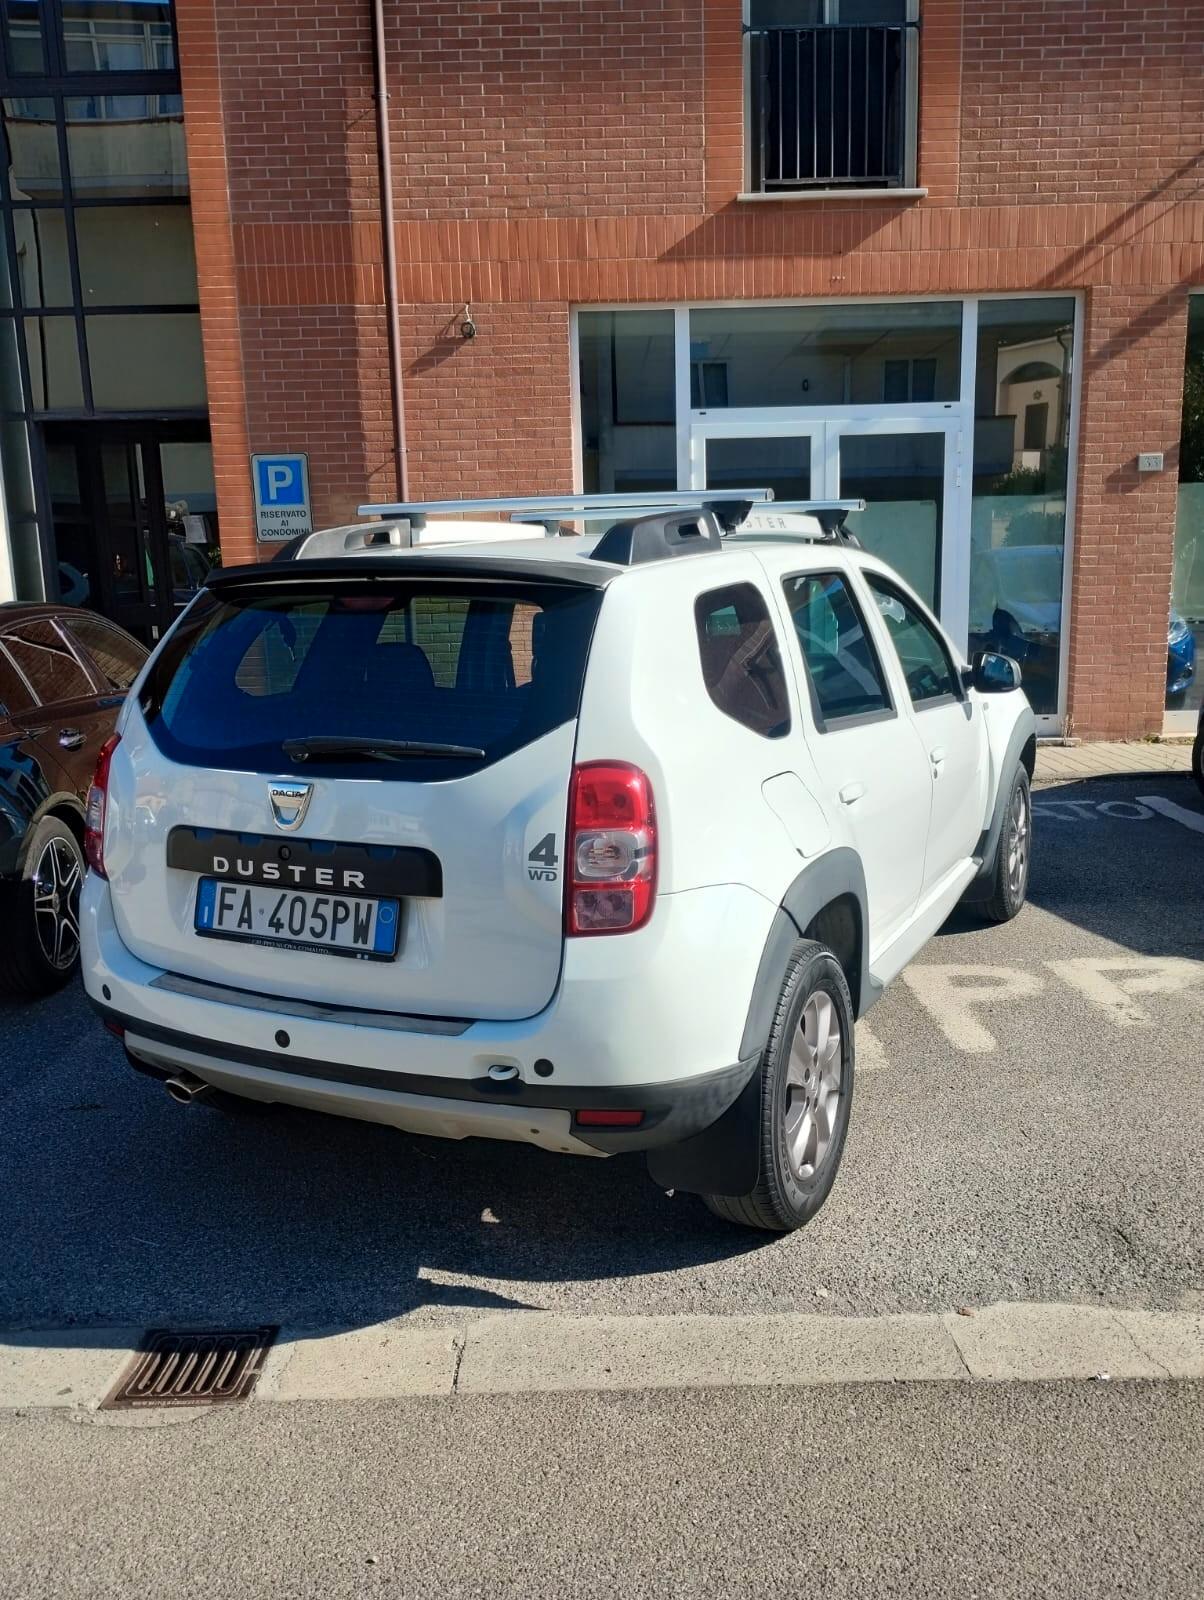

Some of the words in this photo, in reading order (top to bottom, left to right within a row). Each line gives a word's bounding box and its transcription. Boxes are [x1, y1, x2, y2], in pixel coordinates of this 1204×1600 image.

[267, 465, 293, 500] P
[260, 510, 307, 519] RISERVATO
[272, 789, 306, 798] DACIA
[528, 832, 559, 867] 4
[213, 856, 366, 889] DUSTER
[528, 869, 558, 882] WD
[217, 886, 253, 930] FA
[267, 893, 373, 945] 405PW
